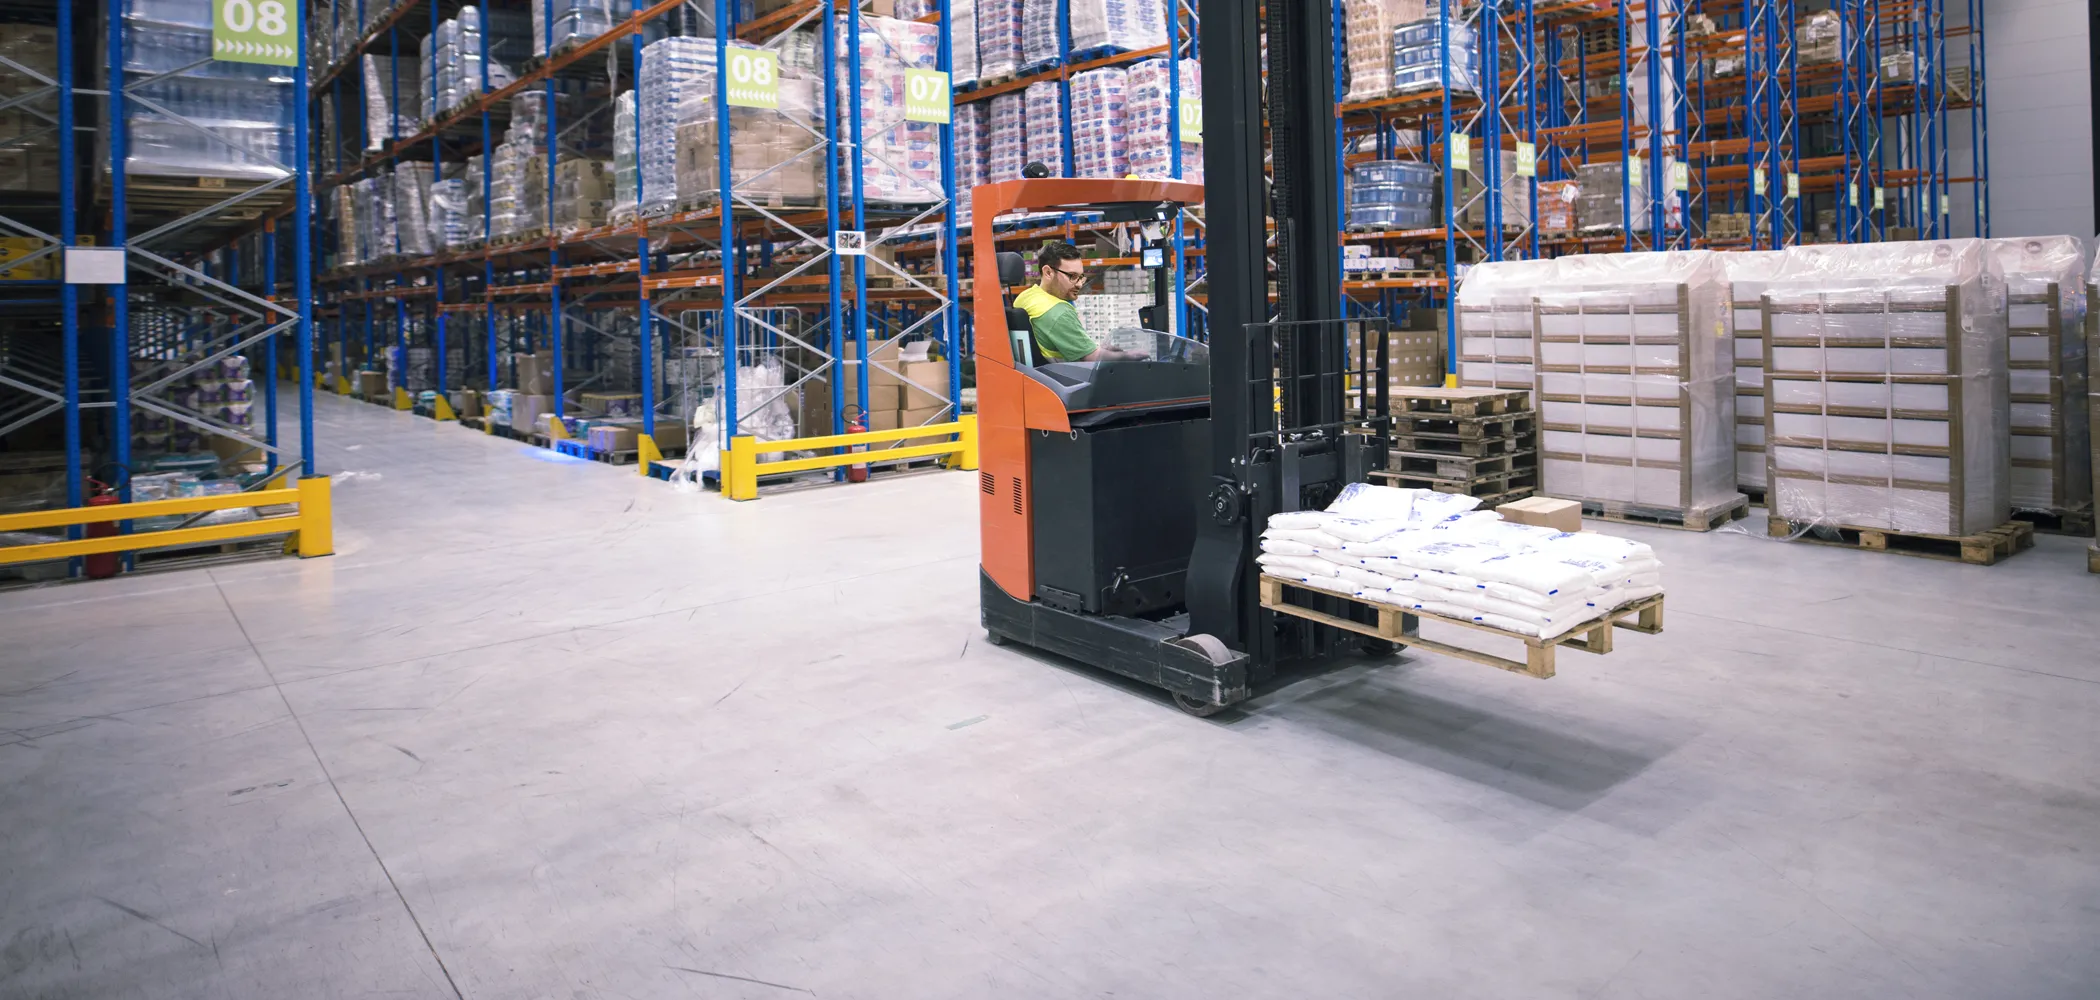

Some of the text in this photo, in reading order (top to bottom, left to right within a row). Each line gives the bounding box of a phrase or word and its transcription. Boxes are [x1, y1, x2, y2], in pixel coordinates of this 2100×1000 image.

[223, 0, 288, 36] 08
[732, 54, 772, 86] 08
[911, 74, 945, 102] 07
[1183, 103, 1202, 125] 07
[1453, 138, 1468, 156] 06
[1519, 146, 1533, 163] 05
